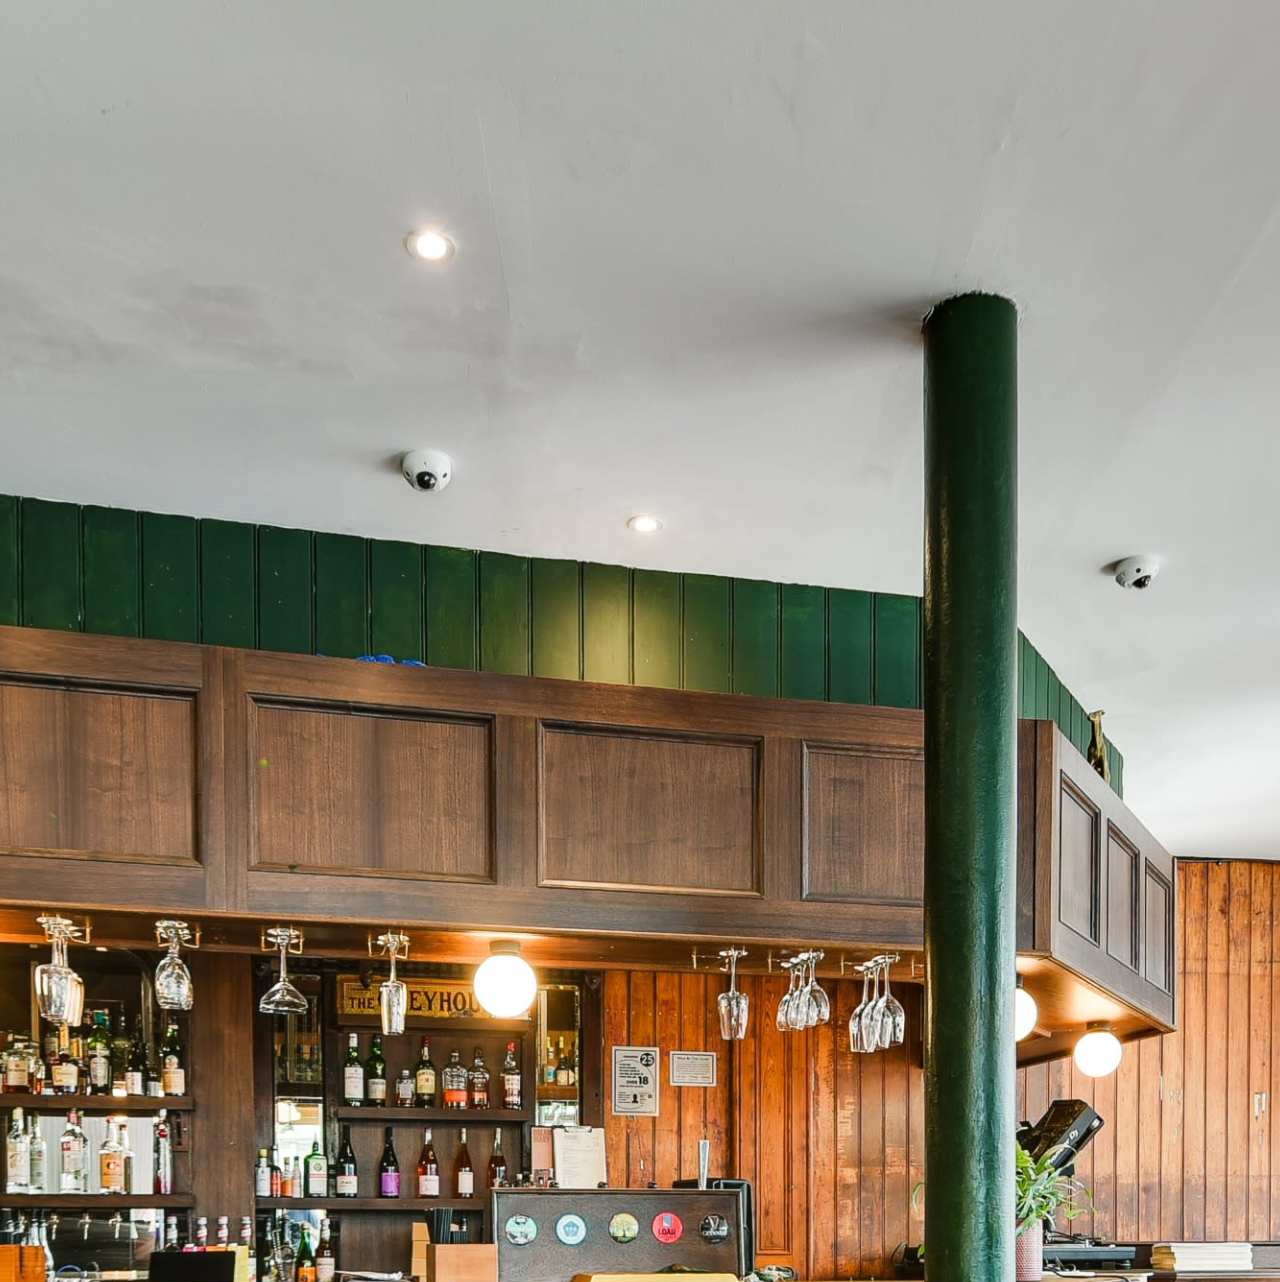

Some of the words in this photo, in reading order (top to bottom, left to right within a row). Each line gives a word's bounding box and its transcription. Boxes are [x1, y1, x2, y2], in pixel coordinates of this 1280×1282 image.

[350, 996, 375, 1009] THE
[641, 1054, 653, 1065] 25
[638, 1076, 649, 1085] 18
